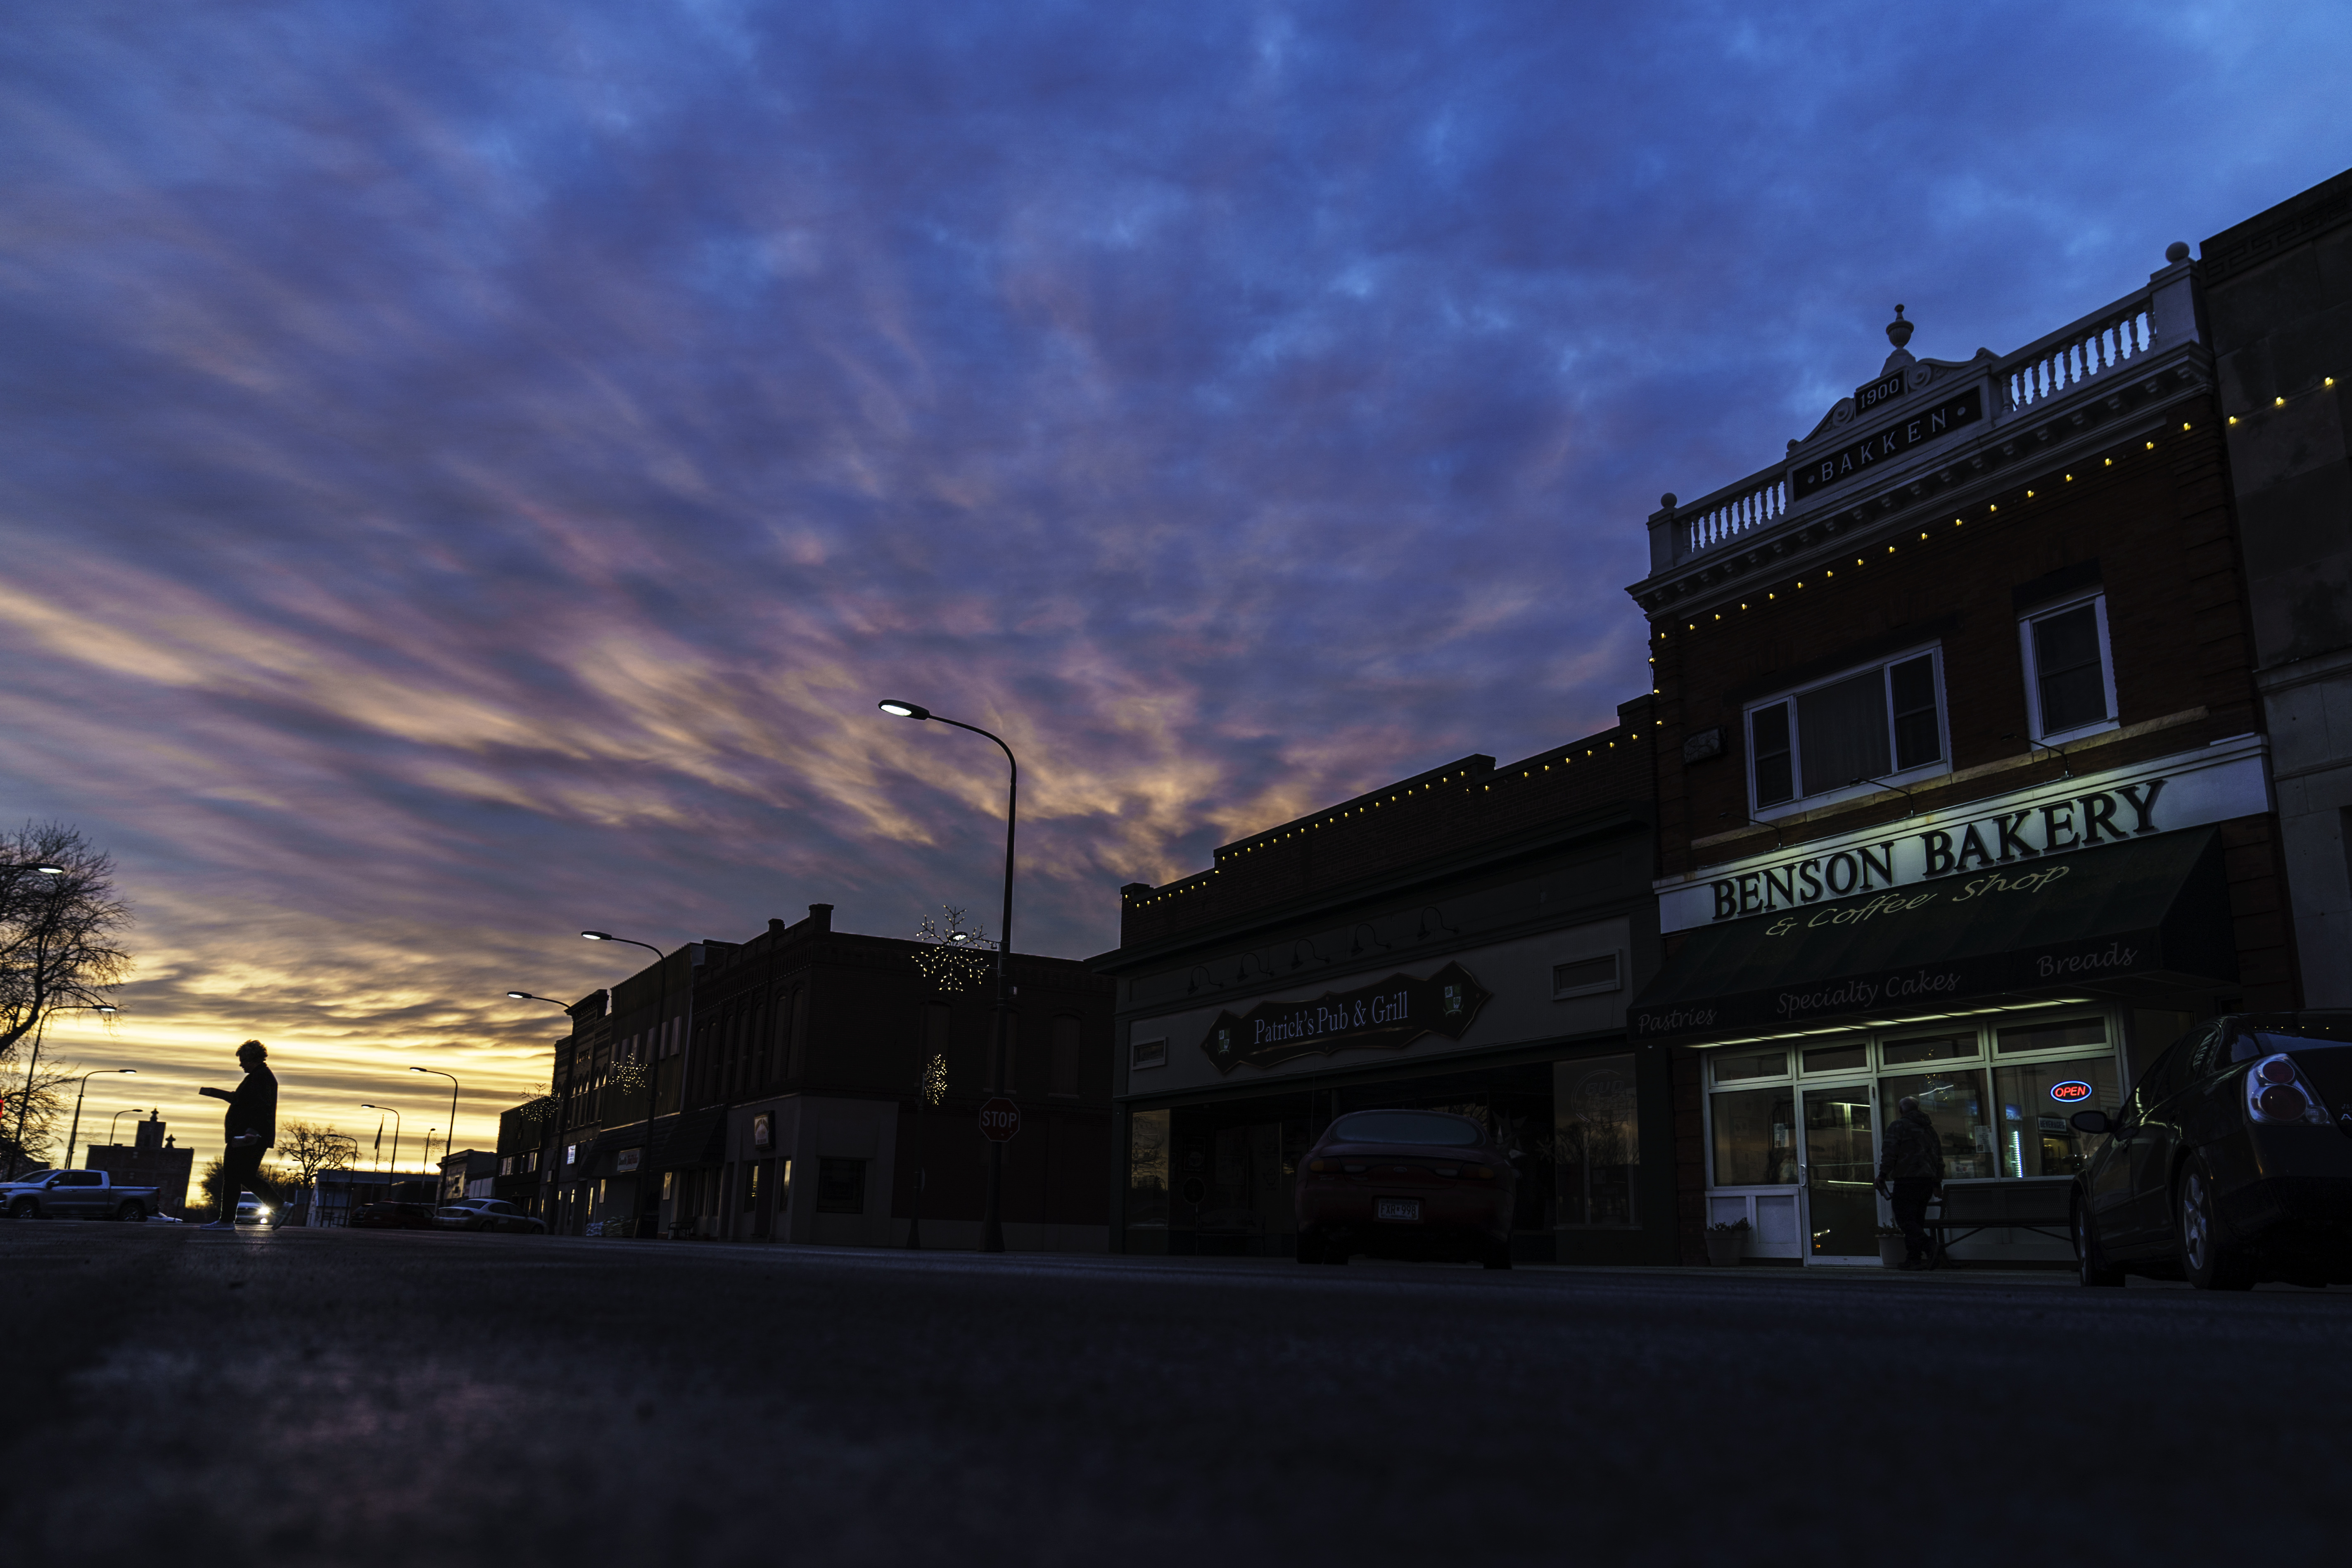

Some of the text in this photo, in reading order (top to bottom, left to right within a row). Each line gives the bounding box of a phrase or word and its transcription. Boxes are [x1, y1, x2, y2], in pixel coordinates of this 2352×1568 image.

[1860, 378, 1899, 409] 1900
[1821, 408, 1948, 483] BAKKEN
[1711, 779, 2163, 920] BENSON BAKERY
[1766, 866, 2070, 936] & Coffee Shop
[2036, 942, 2137, 977] Breads
[1777, 970, 1961, 1019] Specialty Cakes
[1254, 990, 1408, 1044] Patrick's Pub & Grill
[1638, 1008, 1717, 1034] Pastries
[1585, 1080, 1624, 1094] BUD
[2055, 1086, 2086, 1097] OPEN
[982, 1110, 1017, 1128] STOP
[2040, 1120, 2065, 1129] BEVERAGES
[1381, 1204, 1416, 1215] FXR 998
